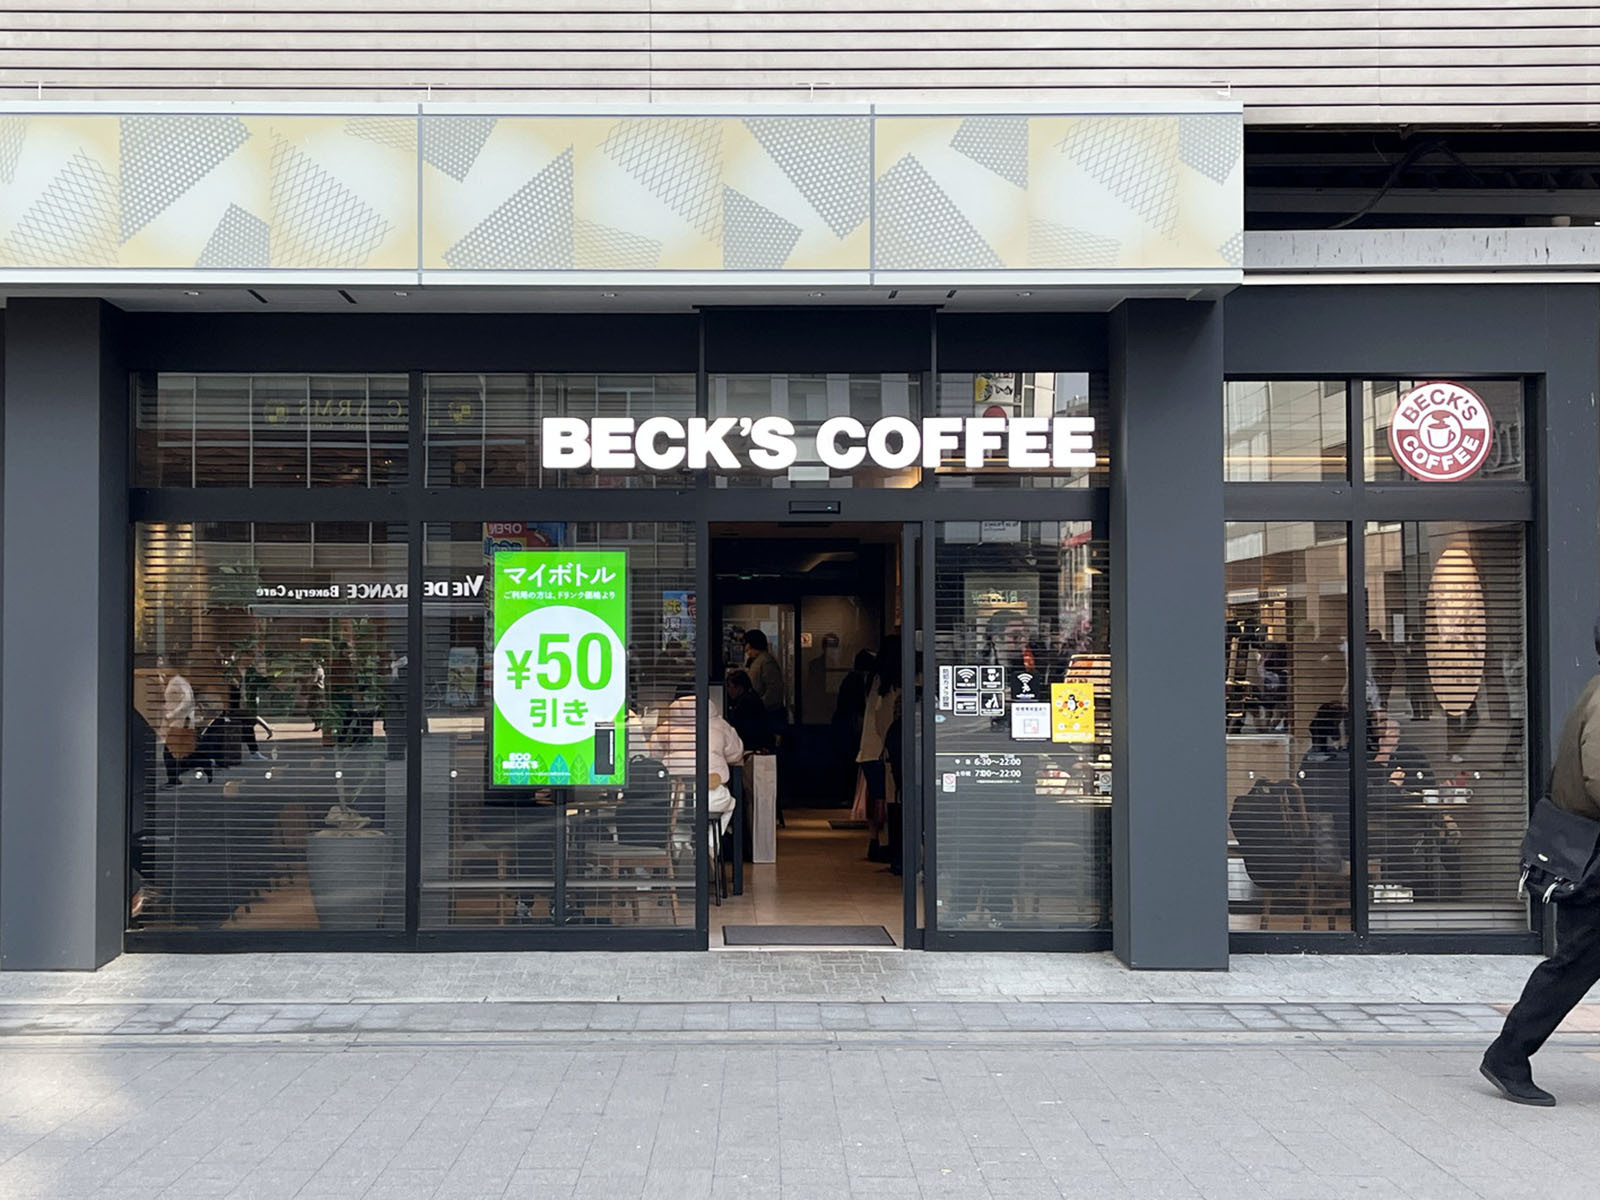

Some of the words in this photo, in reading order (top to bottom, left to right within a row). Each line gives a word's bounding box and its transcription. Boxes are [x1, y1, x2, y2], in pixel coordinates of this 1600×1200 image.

[1401, 389, 1478, 424] BECK'S
[542, 416, 797, 470] BECK'S
[816, 416, 1097, 470] COFFEE
[1403, 435, 1480, 471] COFFEE
[503, 563, 616, 588] マイボトル
[505, 632, 613, 691] ¥50
[529, 698, 589, 728] 引き
[509, 752, 531, 761] ECO
